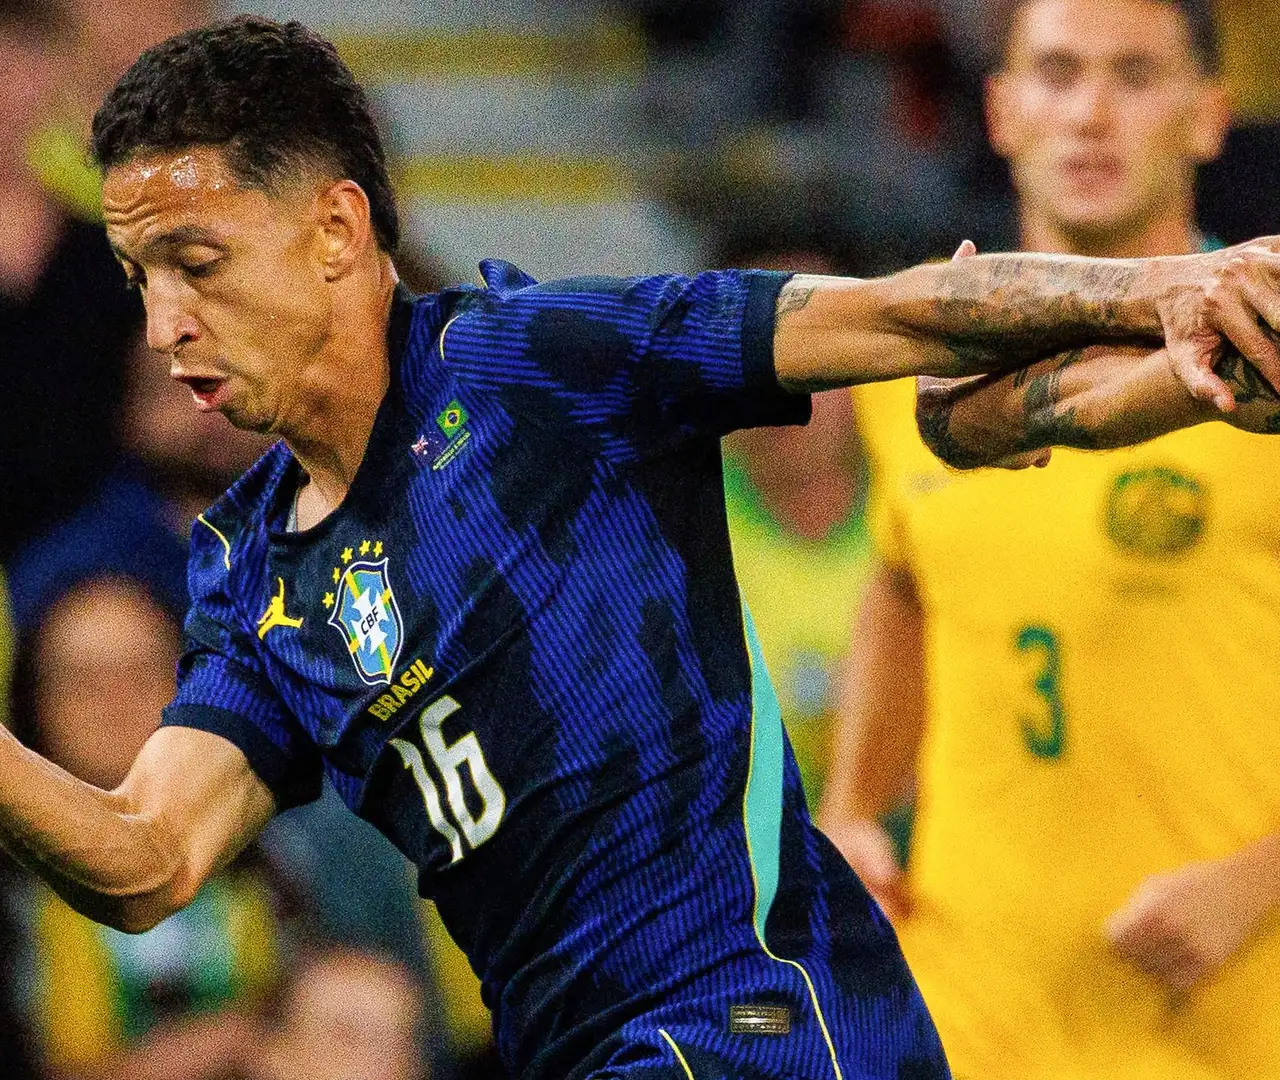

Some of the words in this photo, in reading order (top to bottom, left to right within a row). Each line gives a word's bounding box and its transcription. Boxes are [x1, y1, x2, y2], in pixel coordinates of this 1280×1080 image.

[360, 605, 378, 636] CBF
[367, 658, 434, 722] BRASIL
[1015, 623, 1067, 760] 3
[388, 695, 506, 864] 16
